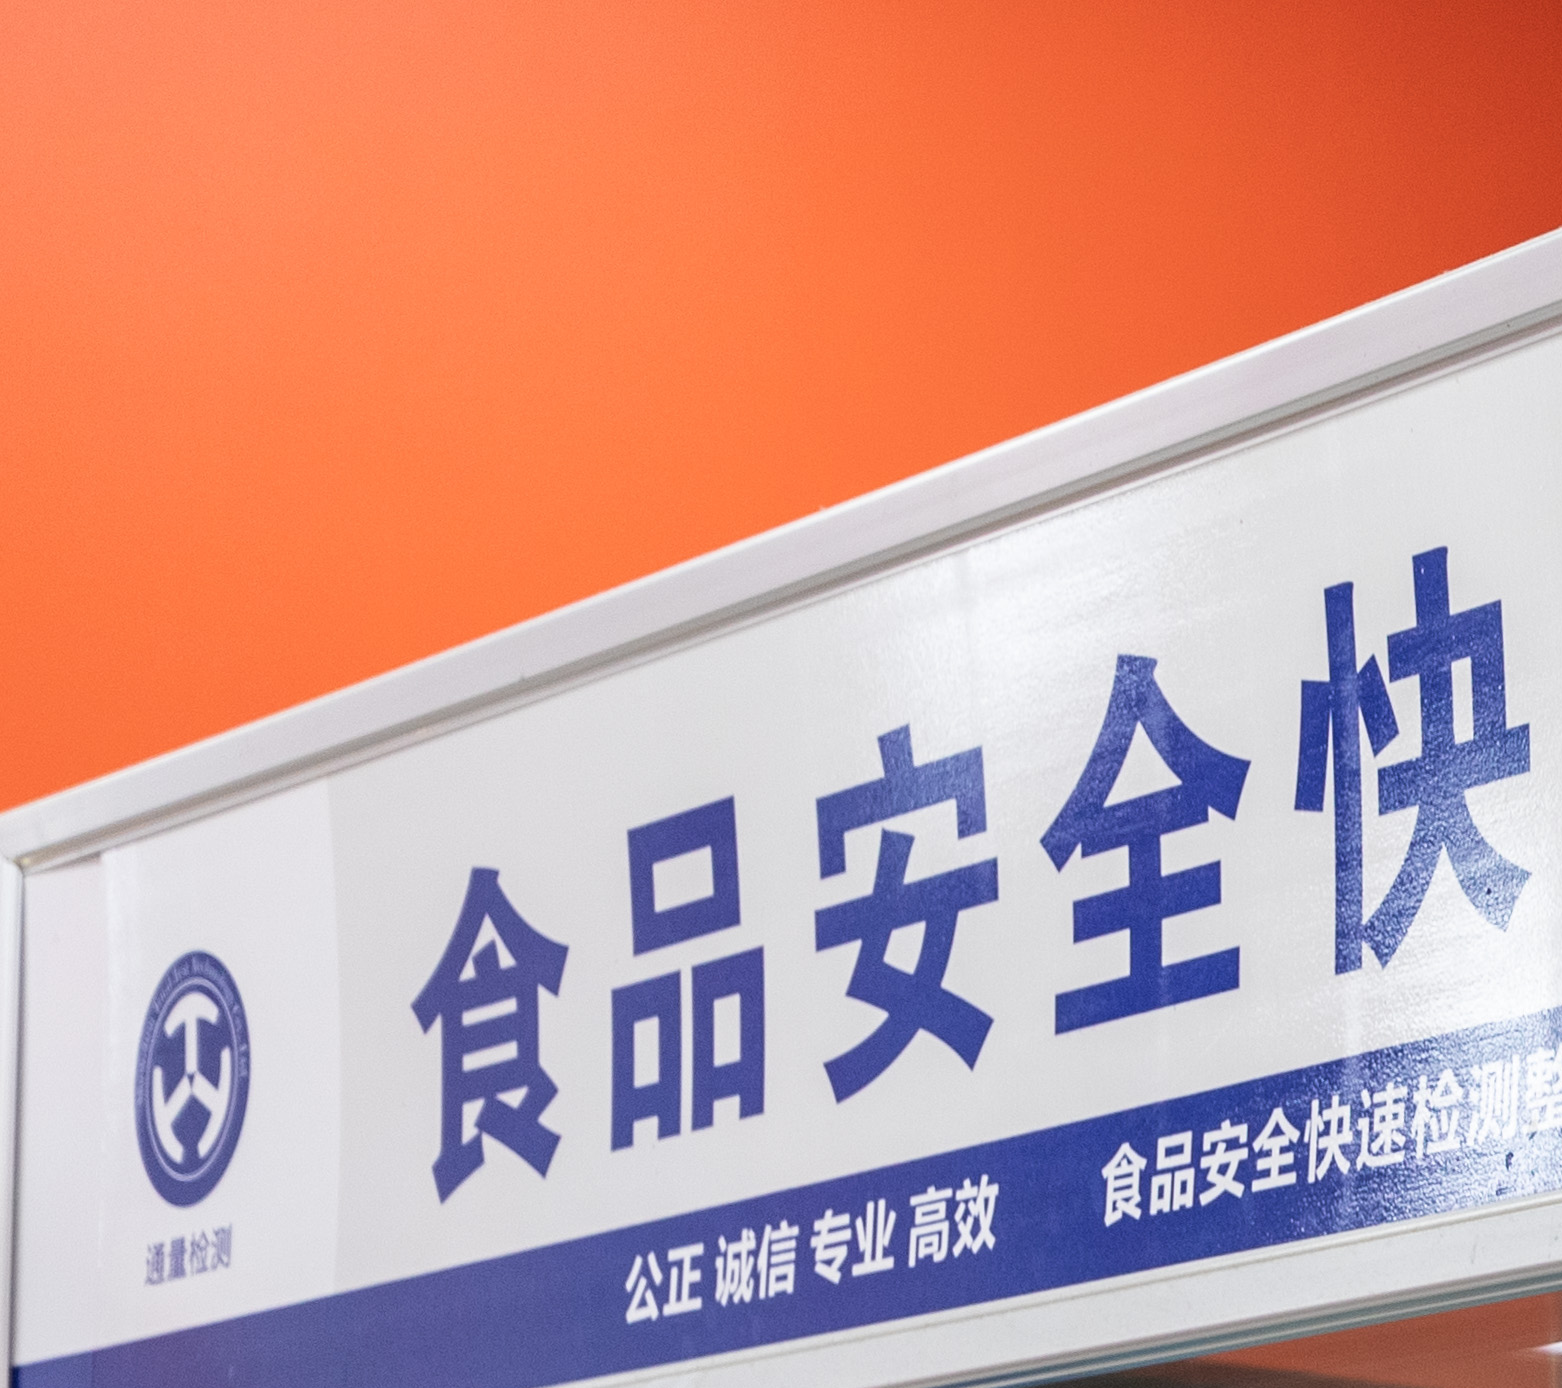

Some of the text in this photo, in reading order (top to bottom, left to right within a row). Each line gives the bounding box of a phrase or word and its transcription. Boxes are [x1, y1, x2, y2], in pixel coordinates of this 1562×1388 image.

[144, 1224, 233, 1286] 通量检测
[625, 1245, 704, 1324] 公正
[714, 1221, 798, 1306] 诚信
[810, 1201, 896, 1286] 专业
[907, 1177, 998, 1271] 高效
